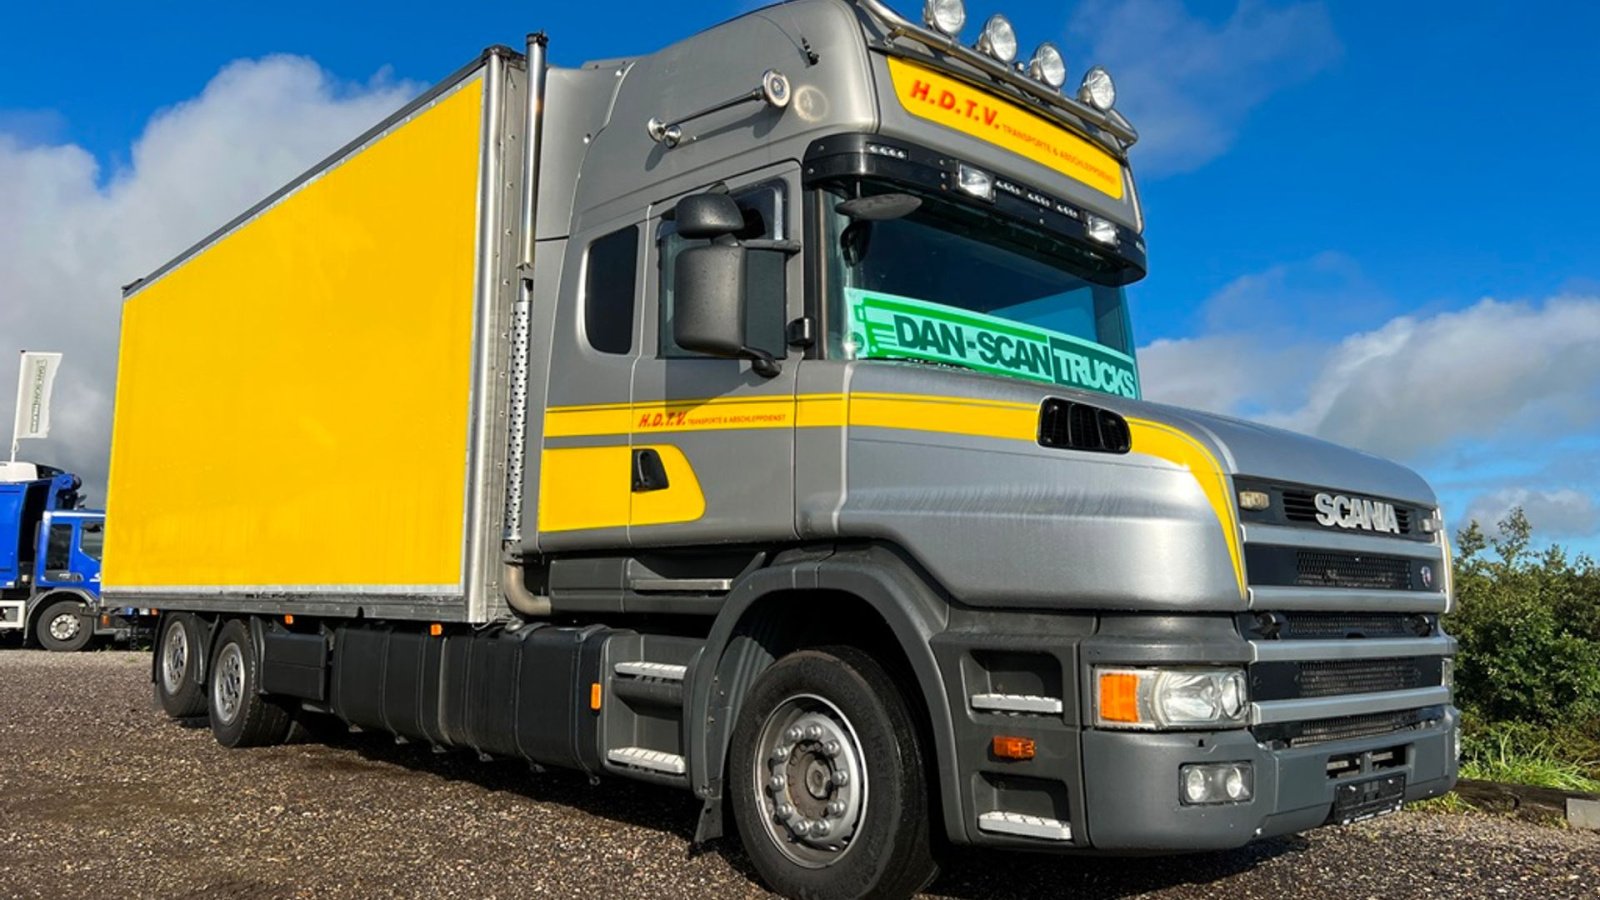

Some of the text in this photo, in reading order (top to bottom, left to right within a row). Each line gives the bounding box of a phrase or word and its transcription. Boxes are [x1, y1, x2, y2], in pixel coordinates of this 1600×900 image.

[909, 79, 1000, 130] H.D.T.V.
[893, 314, 1136, 397] DAN-SCAN TRUCKS
[638, 411, 686, 428] H.D.T.V.
[1314, 492, 1400, 535] SCANIA
